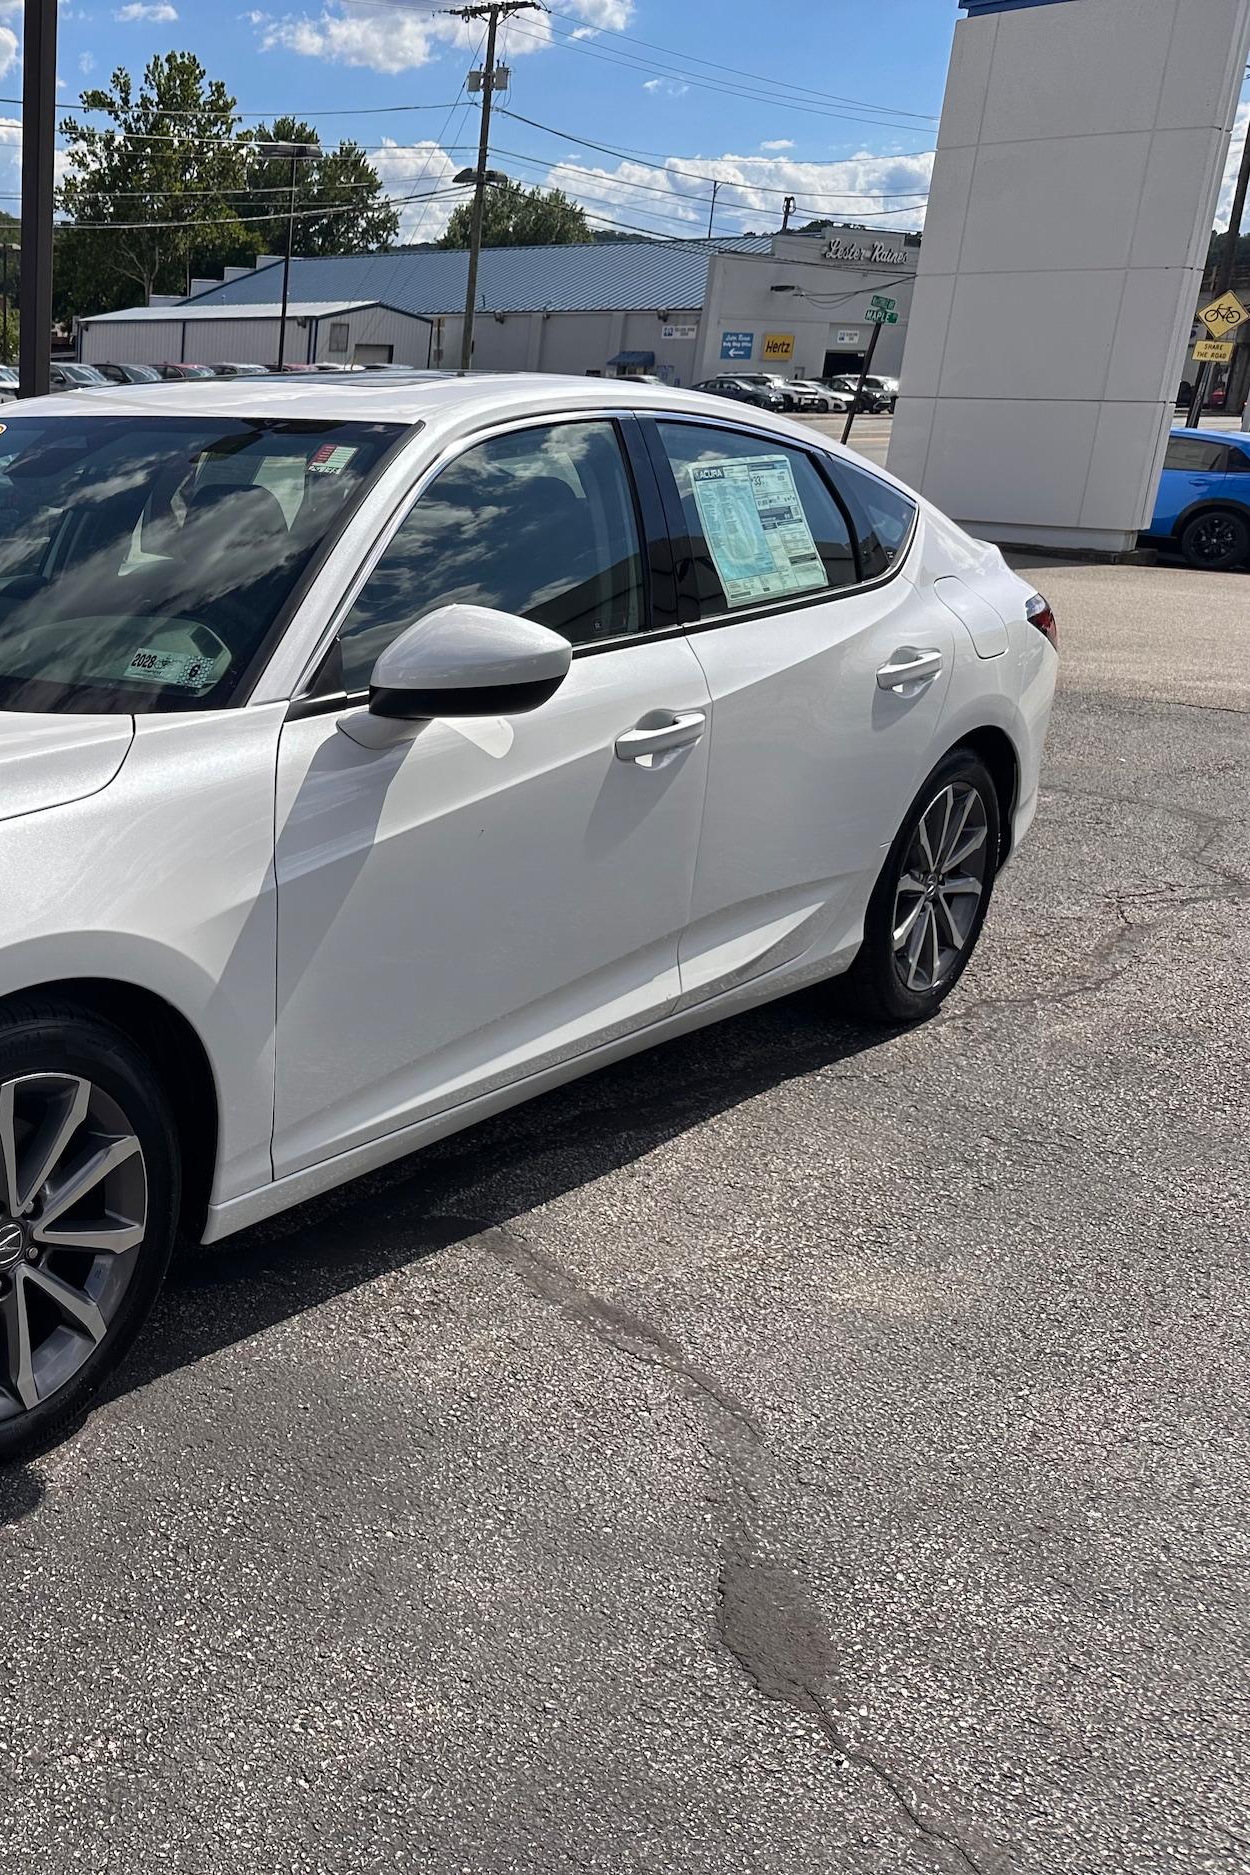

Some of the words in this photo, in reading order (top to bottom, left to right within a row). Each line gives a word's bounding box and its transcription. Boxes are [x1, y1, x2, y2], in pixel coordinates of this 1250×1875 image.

[825, 237, 866, 261] Lester
[866, 310, 891, 322] MAPLE
[765, 340, 791, 354] Hertz
[699, 468, 723, 479] ACURA
[131, 653, 157, 669] 2028
